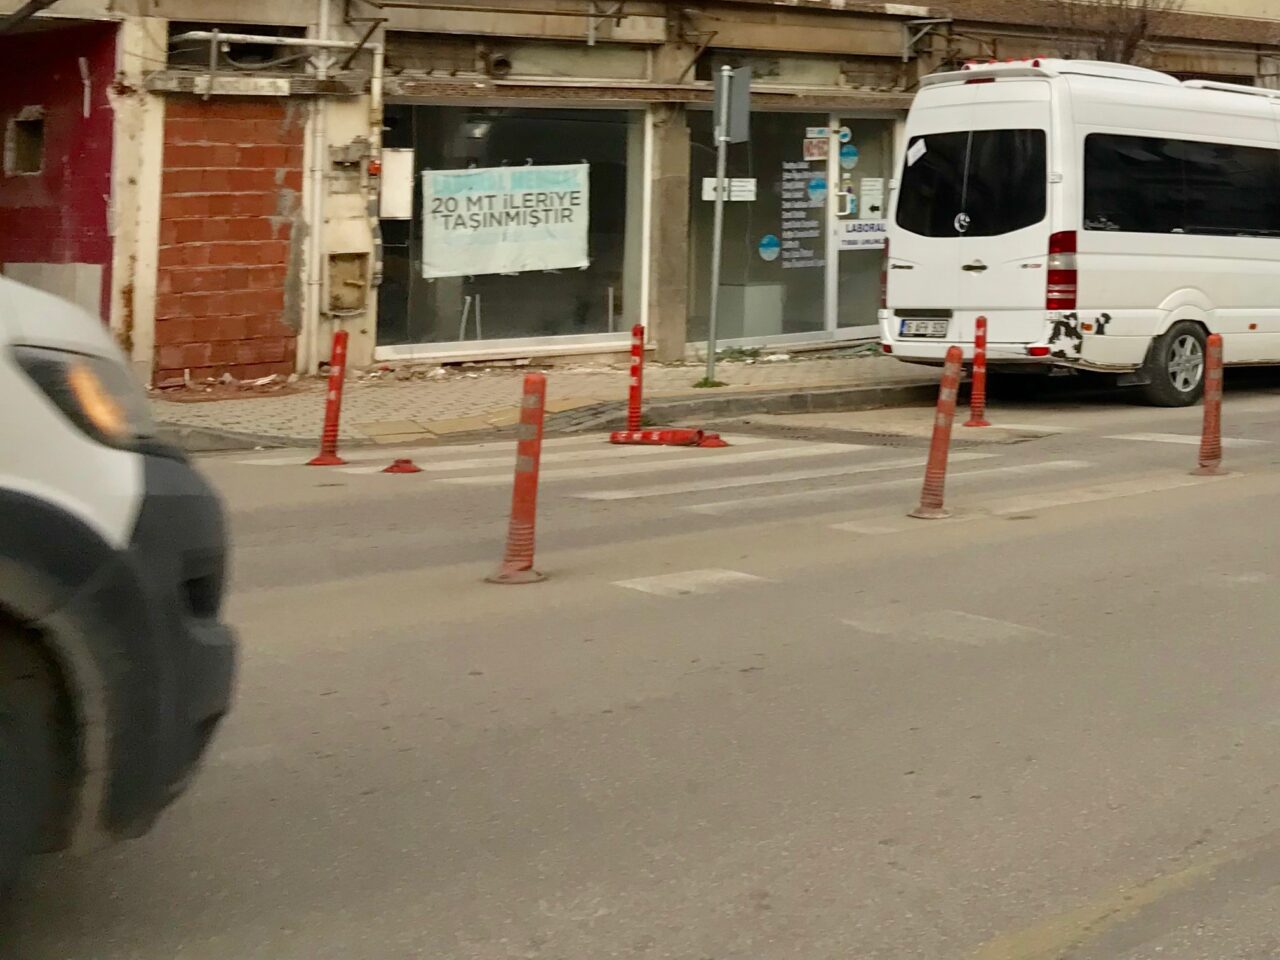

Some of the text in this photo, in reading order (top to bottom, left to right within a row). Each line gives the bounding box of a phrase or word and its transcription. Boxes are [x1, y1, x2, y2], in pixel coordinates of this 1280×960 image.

[432, 197, 458, 214] 20
[466, 194, 497, 212] MT
[441, 207, 574, 231] TAŞINMIŞTIR
